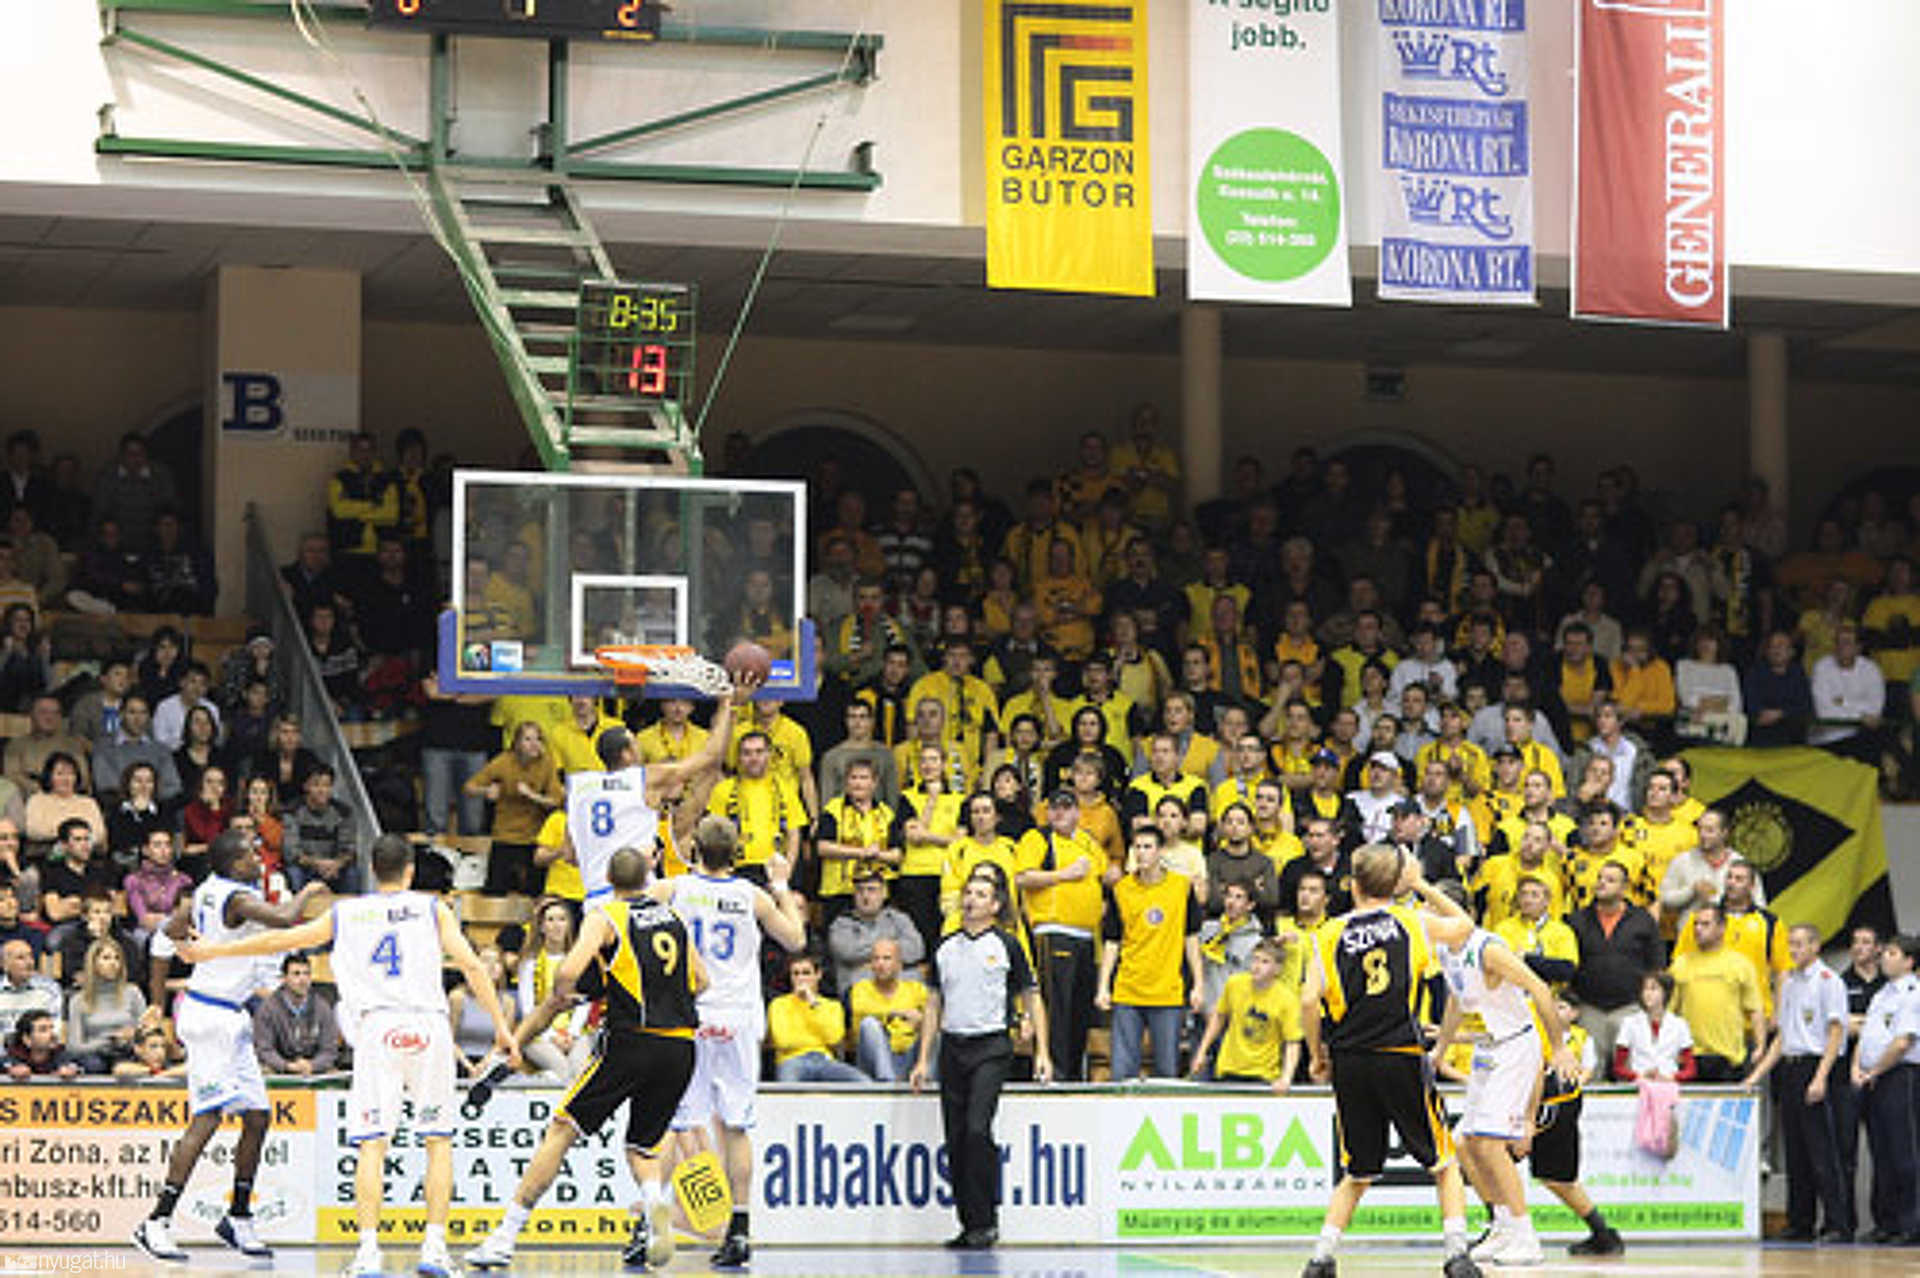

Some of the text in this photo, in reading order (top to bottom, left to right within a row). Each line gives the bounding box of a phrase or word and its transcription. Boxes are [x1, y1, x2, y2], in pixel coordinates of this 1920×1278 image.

[1231, 20, 1307, 51] jobb.
[1001, 145, 1134, 175] GARZON
[1665, 21, 1715, 308] GENERALI
[1382, 244, 1522, 288] KORONA RT.
[610, 294, 677, 331] 8:35
[629, 344, 666, 392] 13
[222, 372, 283, 431] B
[591, 800, 615, 837] 8
[371, 932, 402, 976] 4
[652, 932, 678, 976] 9
[692, 917, 736, 960] 13
[30, 1092, 189, 1123] MŰSZAKI
[30, 1139, 109, 1167] Zóna,
[118, 1145, 150, 1164] az
[1118, 1112, 1325, 1171] ALBA
[763, 1124, 1087, 1209] albakosr.hu
